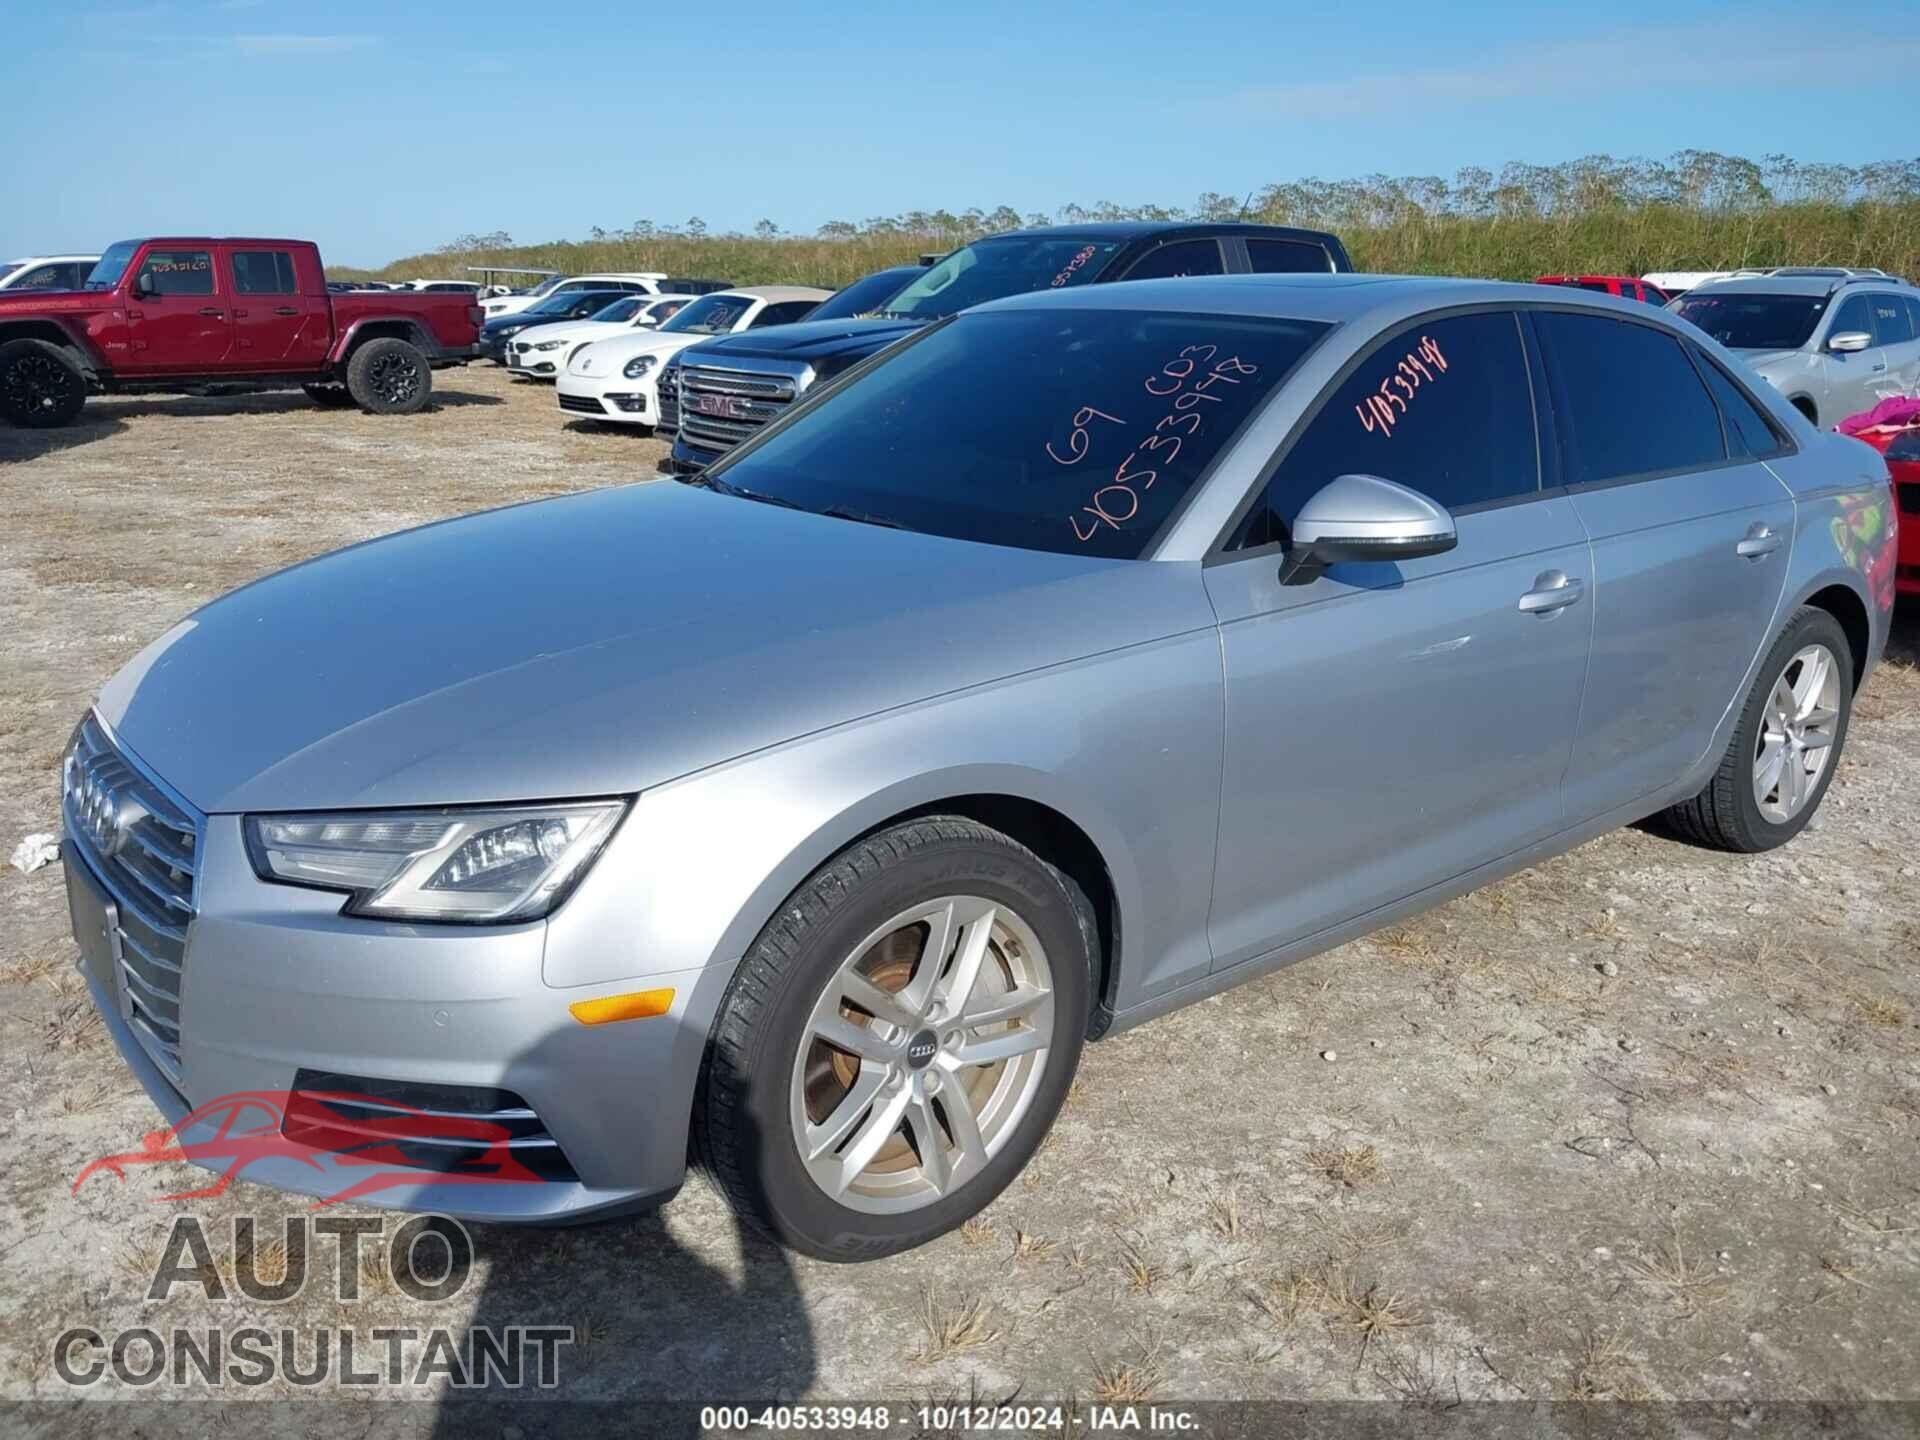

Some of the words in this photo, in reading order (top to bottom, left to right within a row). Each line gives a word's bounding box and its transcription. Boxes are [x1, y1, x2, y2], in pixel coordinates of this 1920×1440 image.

[699, 393, 751, 417] GMC
[1046, 406, 1127, 465] 69
[1069, 355, 1257, 541] 40533948
